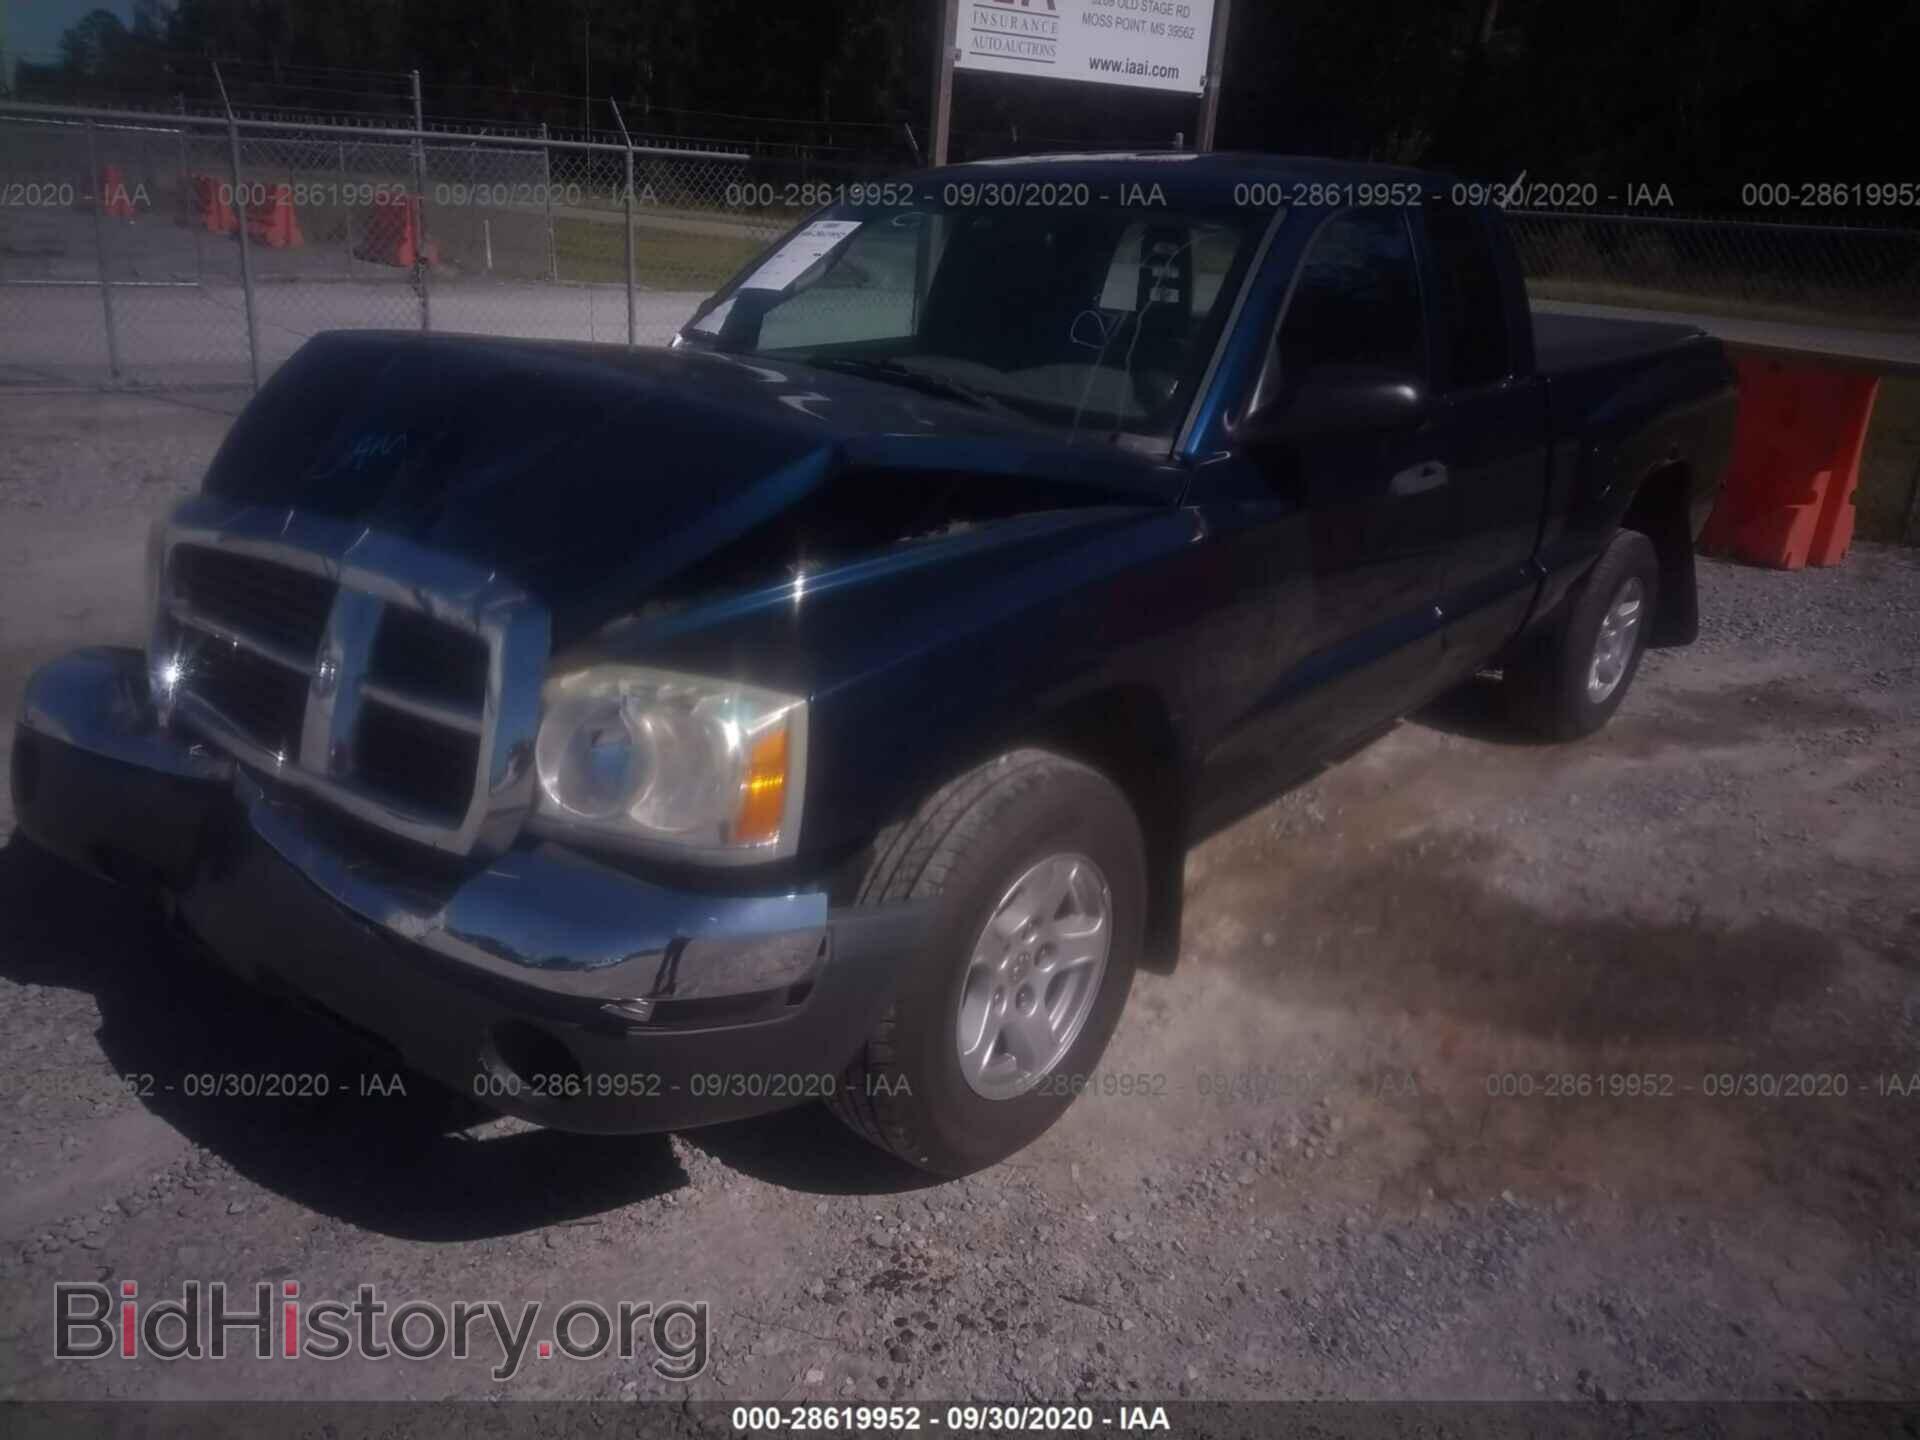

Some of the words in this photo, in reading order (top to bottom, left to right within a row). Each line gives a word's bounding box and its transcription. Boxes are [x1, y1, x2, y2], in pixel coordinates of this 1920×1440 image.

[1116, 0, 1139, 10] OLD
[1140, 0, 1173, 15] STAGE
[1176, 4, 1191, 18] RD
[971, 10, 1058, 34] INSURANCE
[1082, 11, 1113, 28] MOSS
[1150, 21, 1166, 35] MS
[971, 35, 1002, 50] AUTO
[1003, 39, 1057, 57] AUCTIONS
[1089, 57, 1180, 79] www.iaai.com
